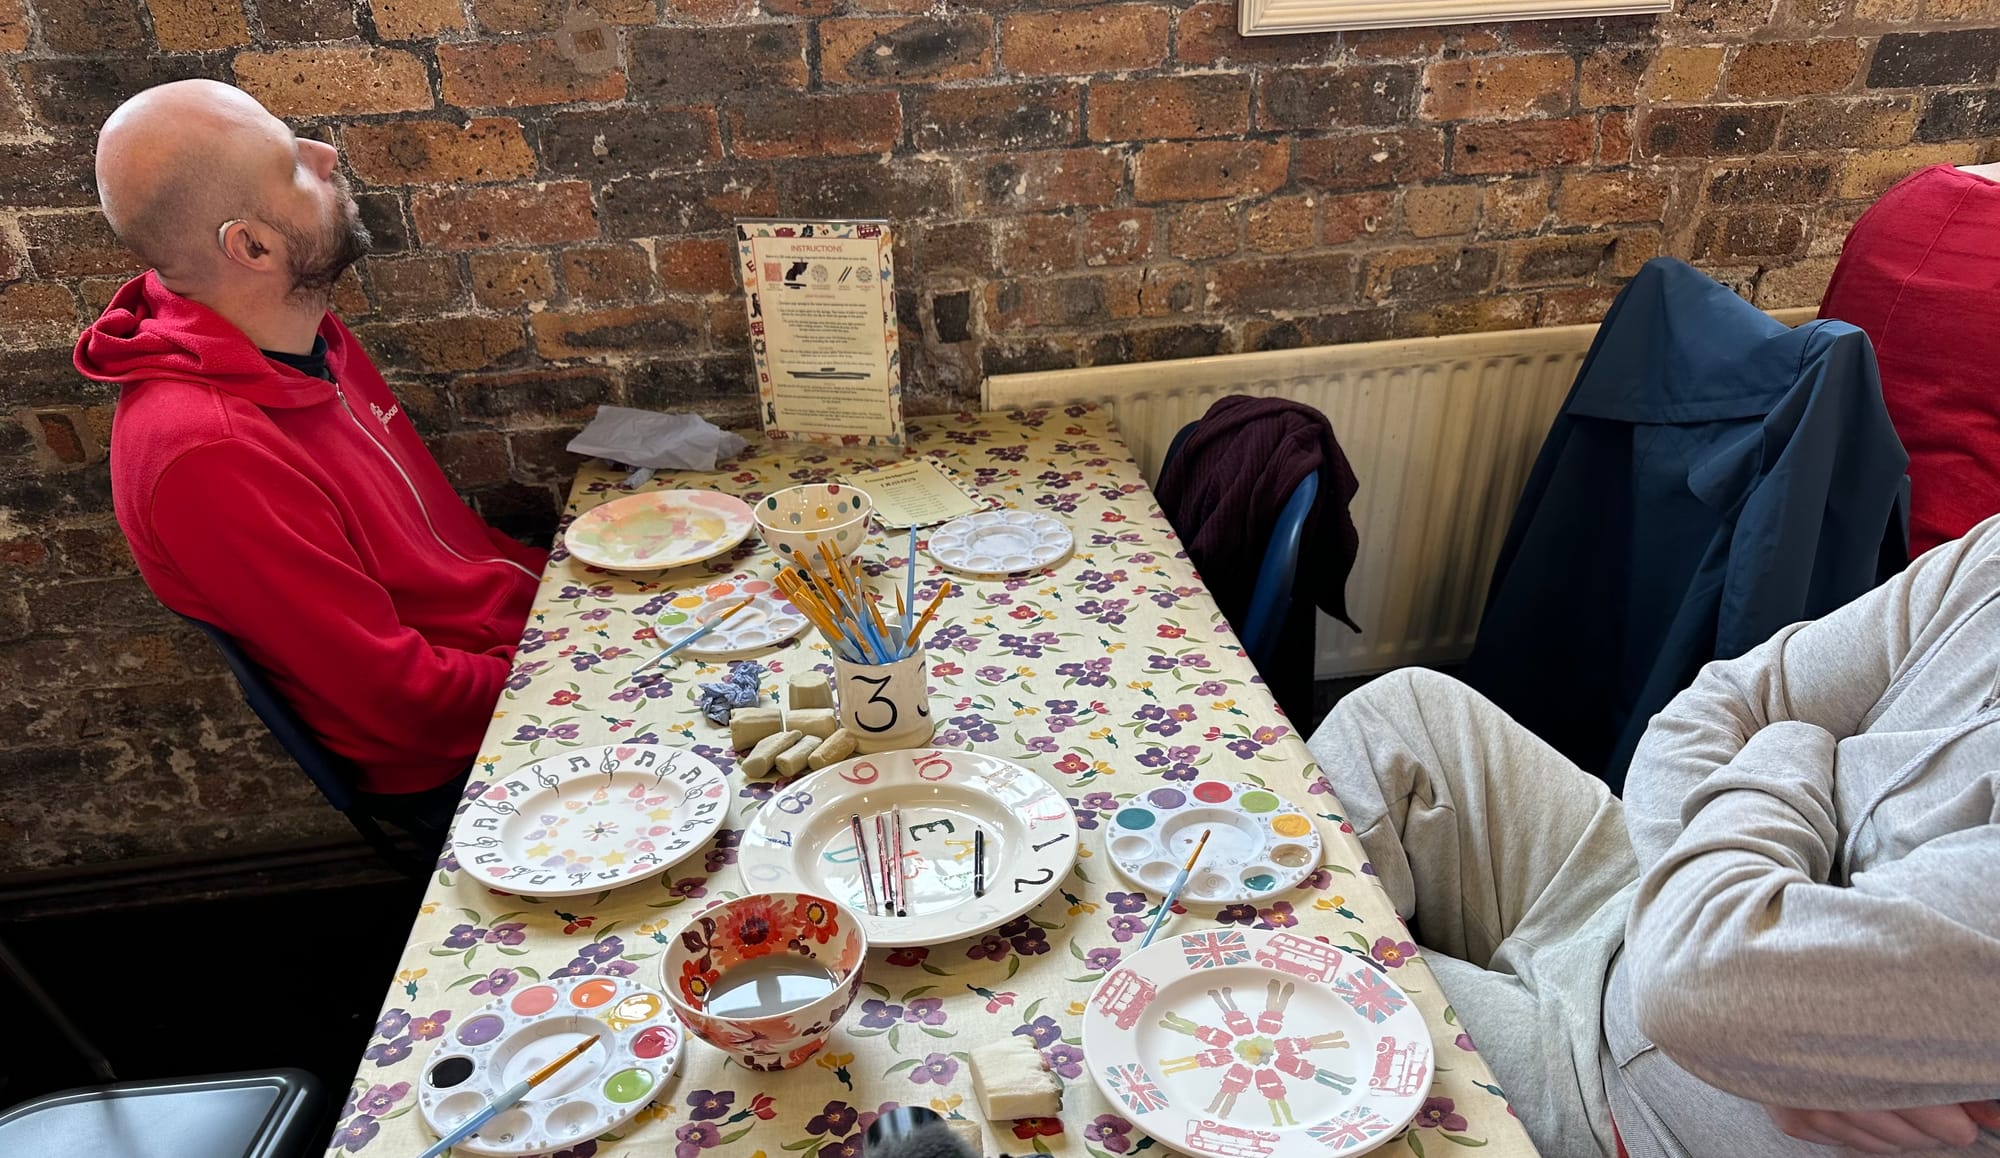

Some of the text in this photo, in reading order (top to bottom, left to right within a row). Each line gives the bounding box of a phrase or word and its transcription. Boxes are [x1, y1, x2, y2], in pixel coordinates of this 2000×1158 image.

[790, 244, 843, 253] INSTRUCTIONS
[850, 674, 898, 733] 3
[838, 762, 879, 785] 9
[912, 751, 953, 781] 10
[776, 791, 813, 814] 8
[909, 818, 955, 842] E
[1032, 833, 1070, 852] 1
[1014, 868, 1054, 893] 2
